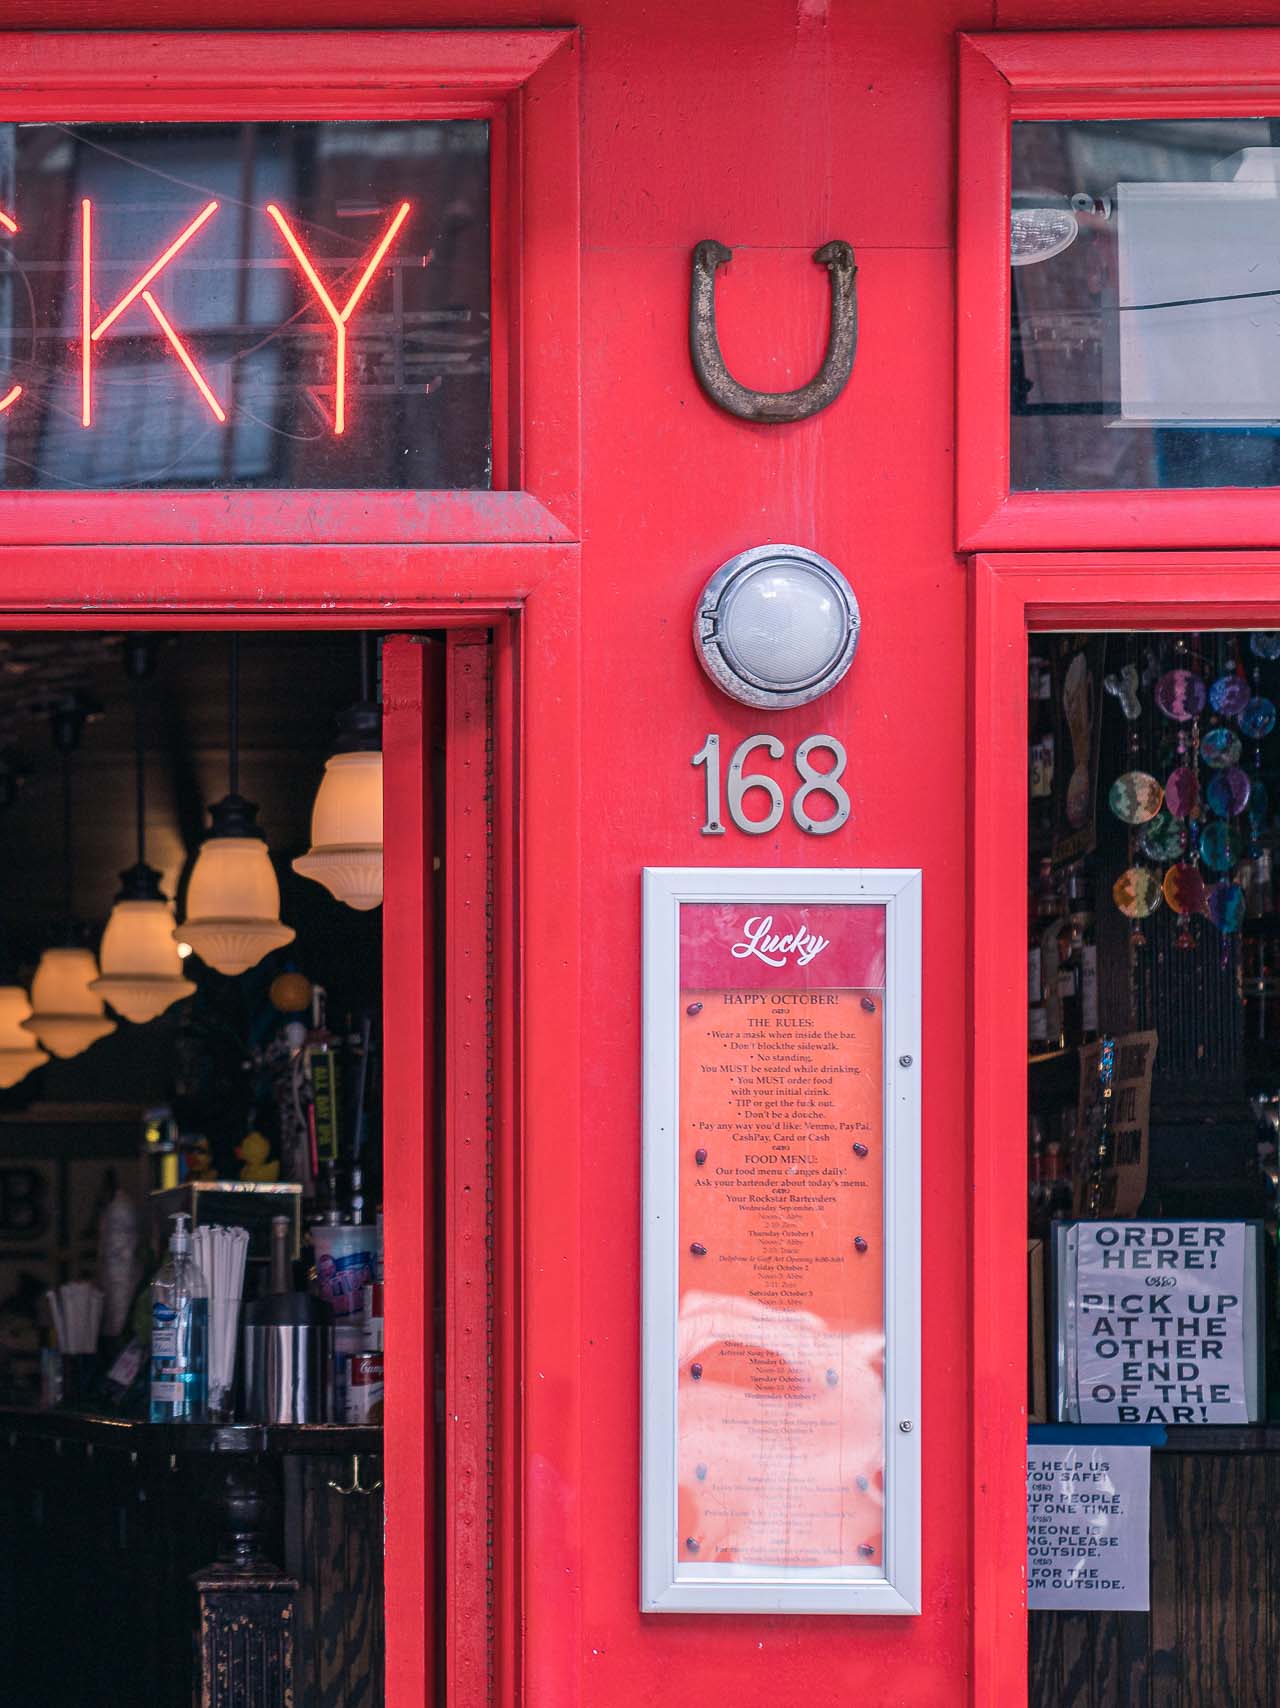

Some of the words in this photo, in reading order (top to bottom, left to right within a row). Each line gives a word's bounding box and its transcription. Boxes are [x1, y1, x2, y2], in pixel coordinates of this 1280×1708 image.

[691, 733, 851, 834] 168
[731, 915, 830, 968] Lucky
[724, 994, 767, 1005] HAPPY
[771, 994, 839, 1005] OCTOBER!
[747, 1018, 770, 1028] THE
[776, 1018, 815, 1028] RULES:
[712, 1031, 733, 1039] Wear
[743, 1031, 766, 1039] mask
[768, 1031, 793, 1039] when
[795, 1031, 821, 1039] inside
[823, 1031, 839, 1039] the
[730, 1042, 755, 1050] Don't
[797, 1042, 839, 1050] sidewalk.
[758, 1054, 770, 1063] No
[772, 1054, 813, 1063] standing.
[701, 1065, 717, 1075] You
[720, 1065, 748, 1075] MUST
[751, 1065, 762, 1075] be
[764, 1065, 791, 1075] seated
[793, 1065, 818, 1075] while
[738, 1077, 754, 1085] You
[756, 1077, 785, 1085] MUST
[787, 1077, 811, 1085] order
[812, 1077, 833, 1085] food
[731, 1088, 751, 1097] with
[753, 1088, 773, 1097] your
[776, 1088, 801, 1097] initial
[802, 1088, 831, 1097] drink.
[735, 1099, 752, 1109] TIP
[753, 1099, 763, 1109] or
[765, 1099, 779, 1109] get
[780, 1099, 795, 1109] the
[796, 1099, 815, 1109] fuck
[818, 1099, 835, 1109] out.
[745, 1111, 770, 1119] Don't
[772, 1111, 783, 1119] be
[792, 1111, 826, 1119] douche.
[699, 1122, 715, 1132] Pay
[717, 1122, 732, 1132] any
[736, 1122, 753, 1132] way
[755, 1122, 781, 1132] you'd
[773, 1134, 795, 1143] Card
[797, 1134, 806, 1143] or
[808, 1134, 830, 1143] Cash
[745, 1155, 777, 1164] FOOD
[780, 1155, 819, 1164] MENU:
[716, 1167, 733, 1177] Our
[735, 1167, 755, 1177] food
[758, 1167, 783, 1177] menu
[695, 1179, 712, 1188] Ask
[714, 1179, 734, 1188] your
[736, 1179, 778, 1188] bartender
[780, 1179, 805, 1188] about
[808, 1179, 839, 1188] today's
[726, 1194, 746, 1204] Your
[749, 1194, 788, 1204] Rockstar
[790, 1194, 836, 1204] Bartenders
[1095, 1227, 1226, 1247] ORDER
[1103, 1250, 1217, 1269] HERE!
[1082, 1294, 1172, 1314] PICK
[1188, 1294, 1238, 1314] UP
[1092, 1317, 1139, 1336] AT
[1152, 1317, 1227, 1336] THE
[1096, 1339, 1223, 1359] OTHER
[1123, 1362, 1200, 1381] END
[1092, 1384, 1141, 1404] OF
[1154, 1384, 1231, 1404] THE
[1117, 1406, 1209, 1423] BAR!
[1042, 1462, 1083, 1471] HELP
[1089, 1462, 1110, 1471] US
[1060, 1494, 1120, 1503] PEOPLE
[1044, 1504, 1076, 1514] ONE
[1084, 1504, 1124, 1514] TIME.
[1058, 1537, 1119, 1546] PLEASE
[1028, 1547, 1101, 1557] OUTSIDE.
[1031, 1568, 1062, 1578] FOR
[1068, 1568, 1099, 1578] THE
[1052, 1579, 1125, 1589] OUTSIDE.
